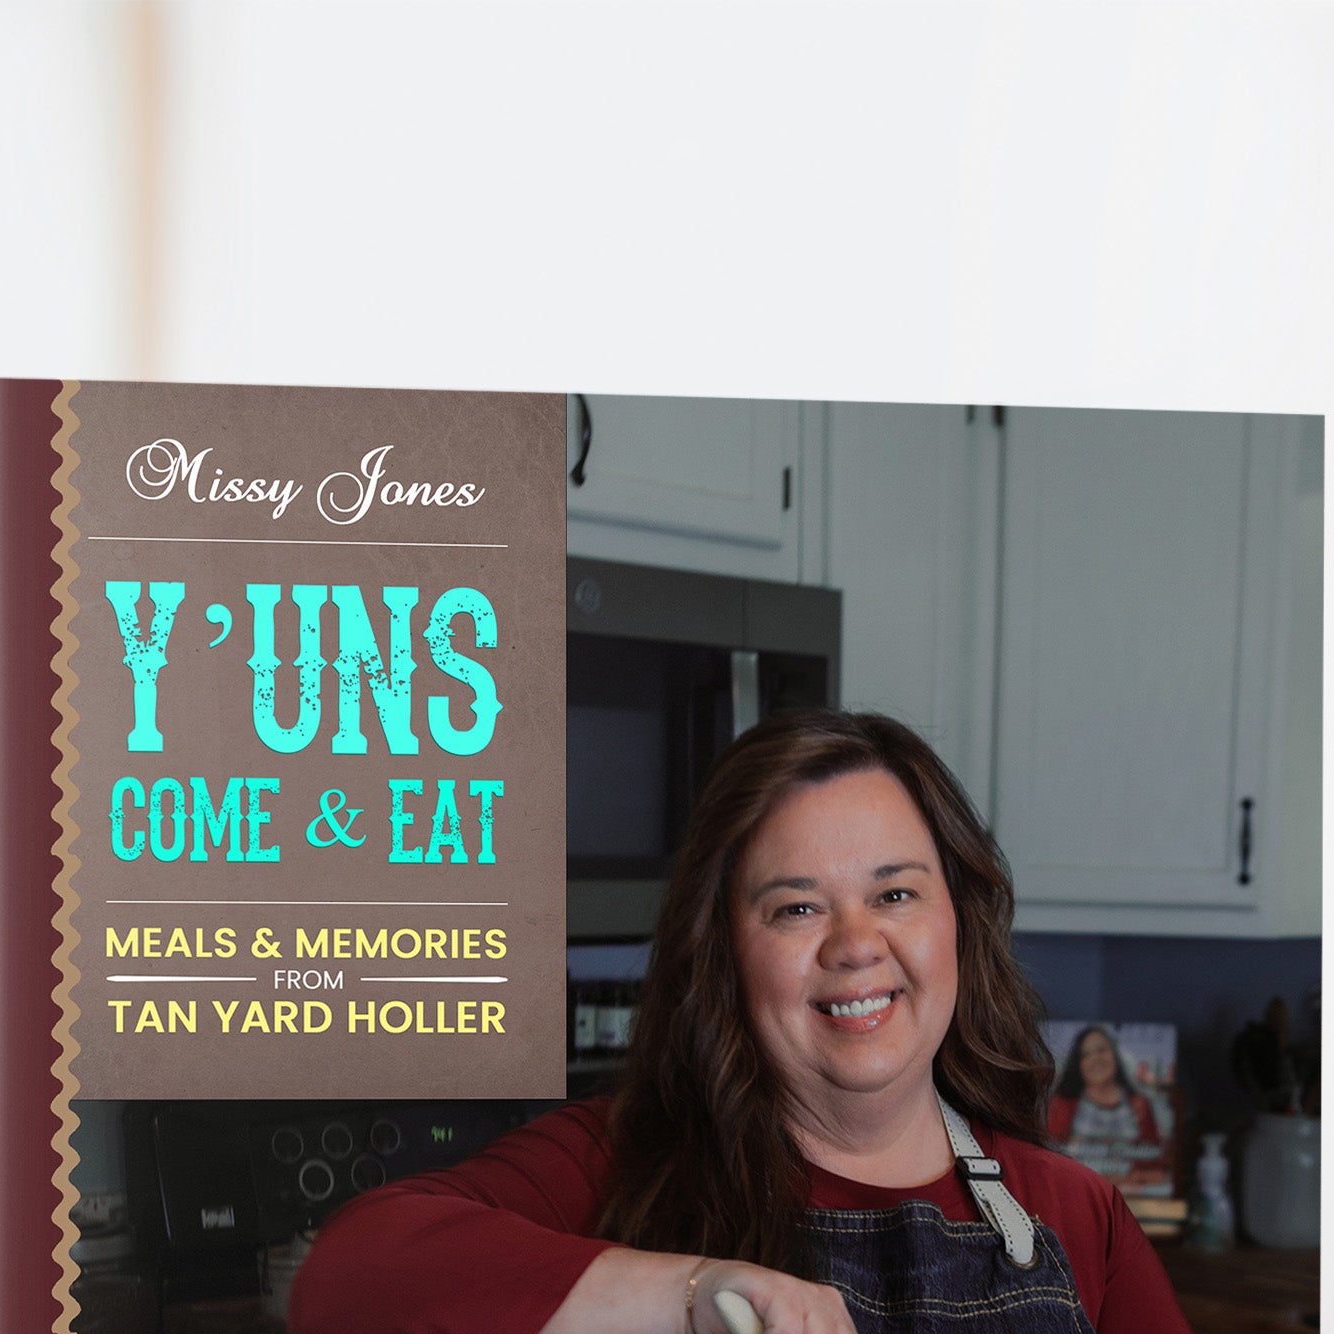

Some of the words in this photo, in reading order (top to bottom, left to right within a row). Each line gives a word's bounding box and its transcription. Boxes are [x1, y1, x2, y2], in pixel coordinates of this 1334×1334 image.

[126, 438, 304, 520] Missy
[317, 445, 486, 525] Jones
[105, 581, 504, 756] Y'UNS
[109, 777, 281, 863] COME
[306, 789, 366, 849] &
[388, 779, 505, 864] EAT
[106, 928, 237, 958] MEALS
[251, 927, 282, 959] &
[296, 928, 507, 959] MEMORIES
[274, 970, 344, 990] FROM
[108, 1001, 197, 1033] TAN
[212, 1001, 332, 1033] YARD
[349, 1001, 506, 1034] HOLLER
